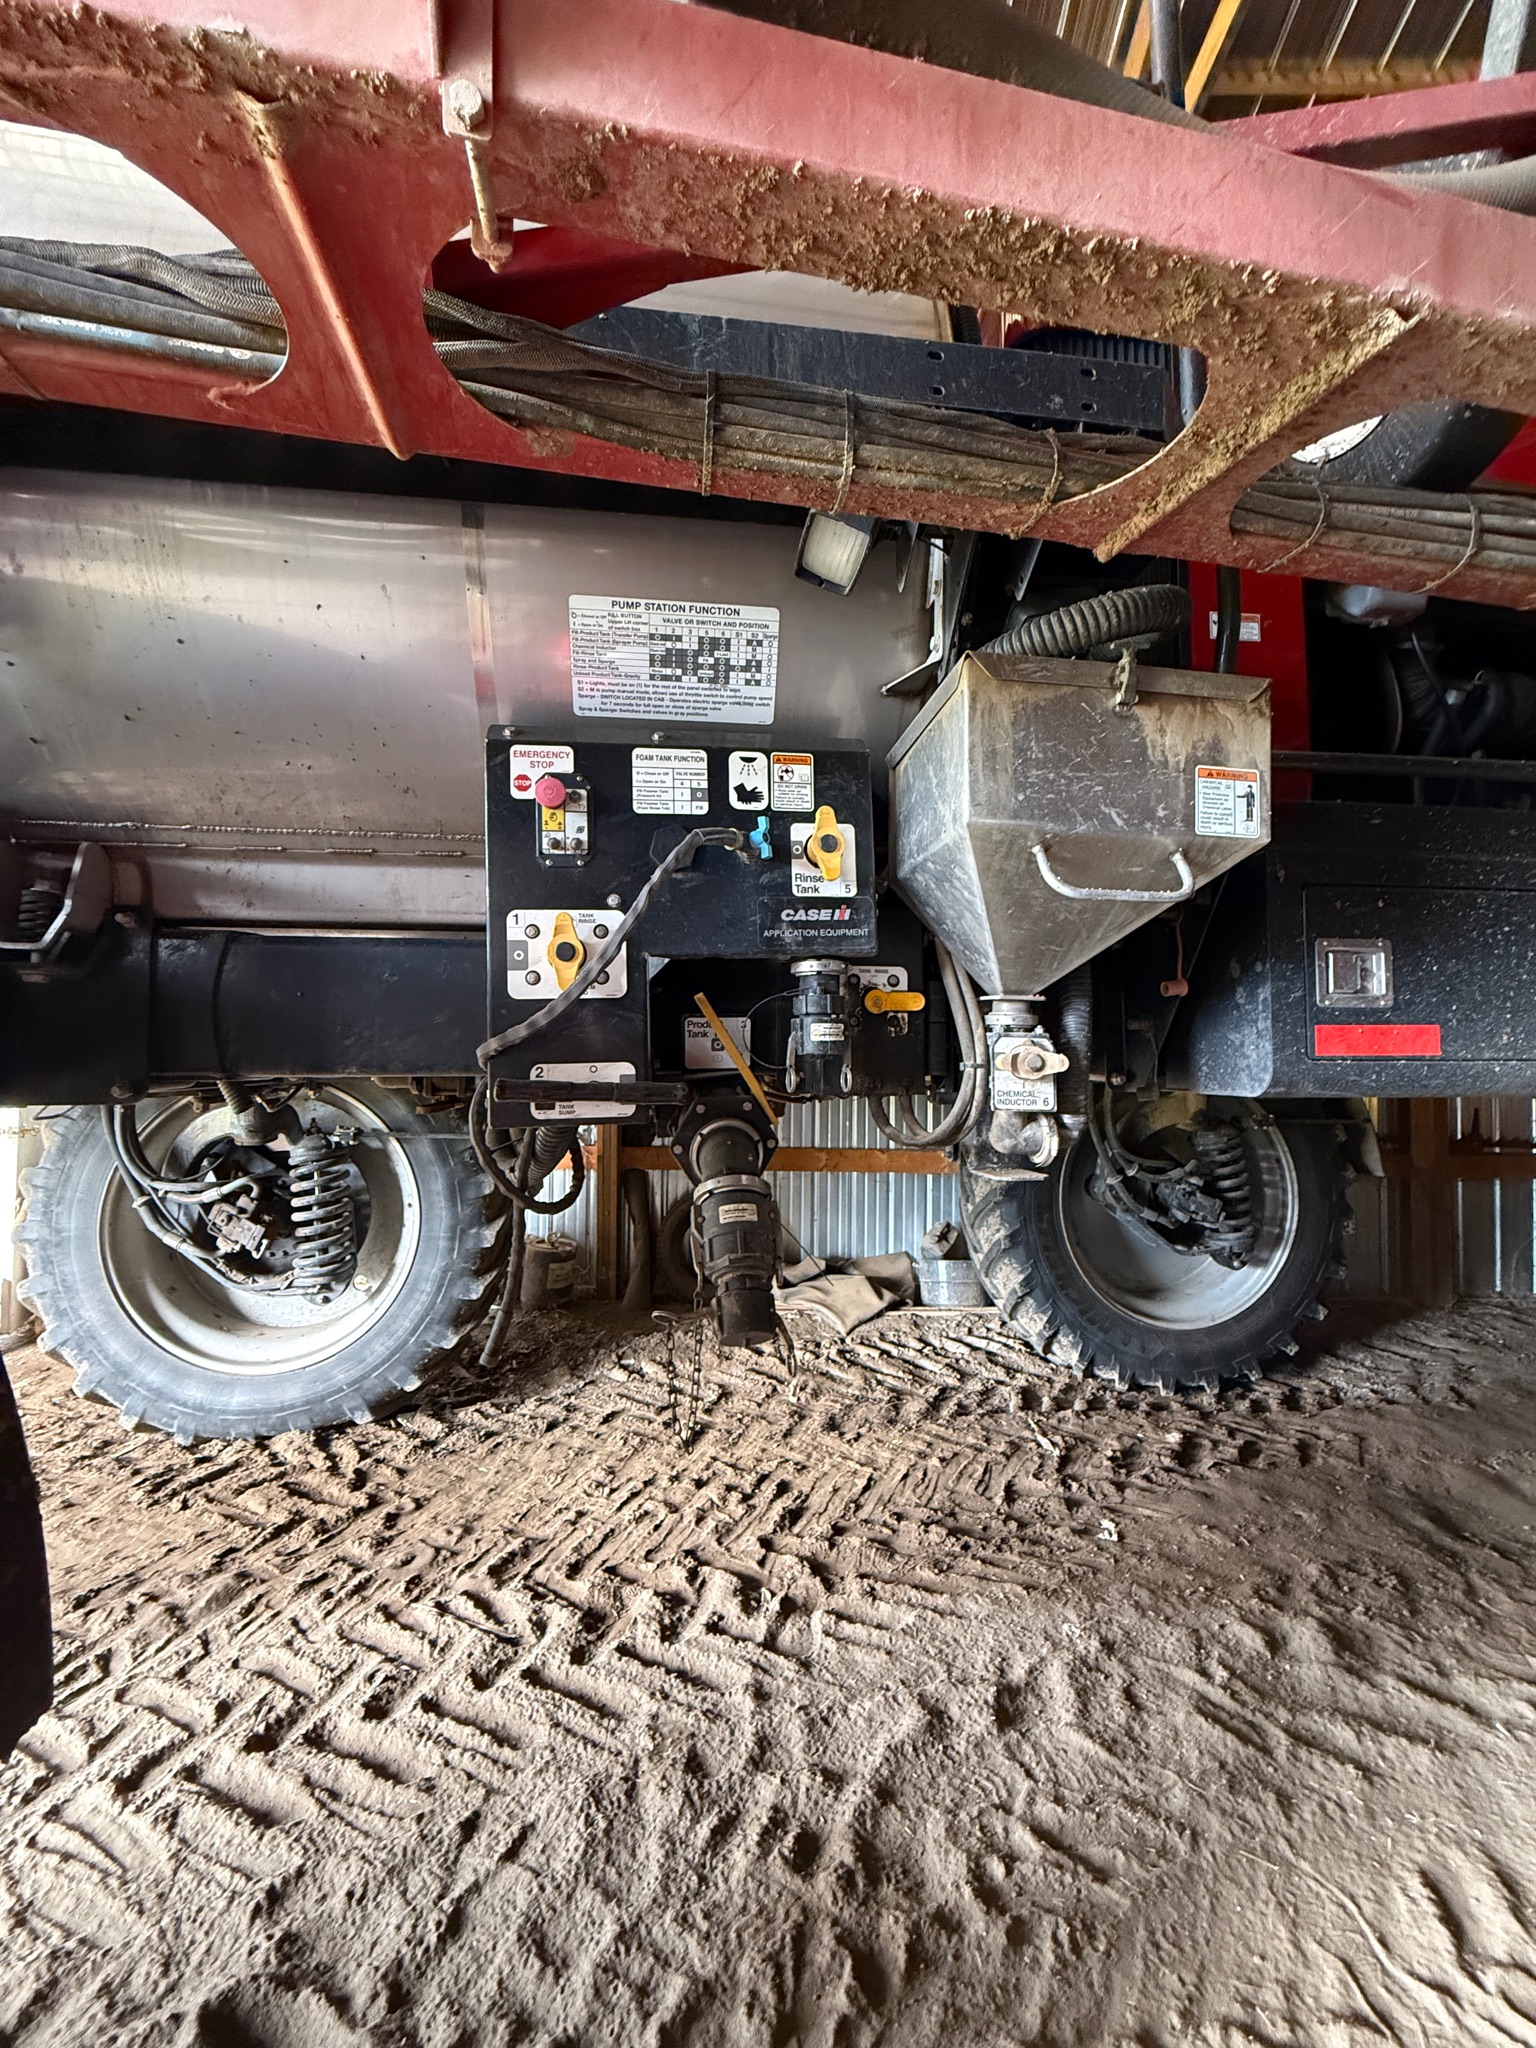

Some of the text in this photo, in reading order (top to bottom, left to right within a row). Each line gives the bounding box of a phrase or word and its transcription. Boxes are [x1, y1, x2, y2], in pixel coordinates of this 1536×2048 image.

[612, 600, 740, 616] PUMP STATION FUNCTION
[513, 750, 570, 759] EMERGENCY
[795, 873, 824, 883] Rinse
[795, 884, 851, 894] Tank 5
[513, 913, 518, 925] 1
[781, 909, 833, 921] CASE
[763, 929, 869, 937] APPLICATION EQUIPMENT
[535, 1067, 544, 1078] 2
[1043, 1097, 1049, 1106] 6
